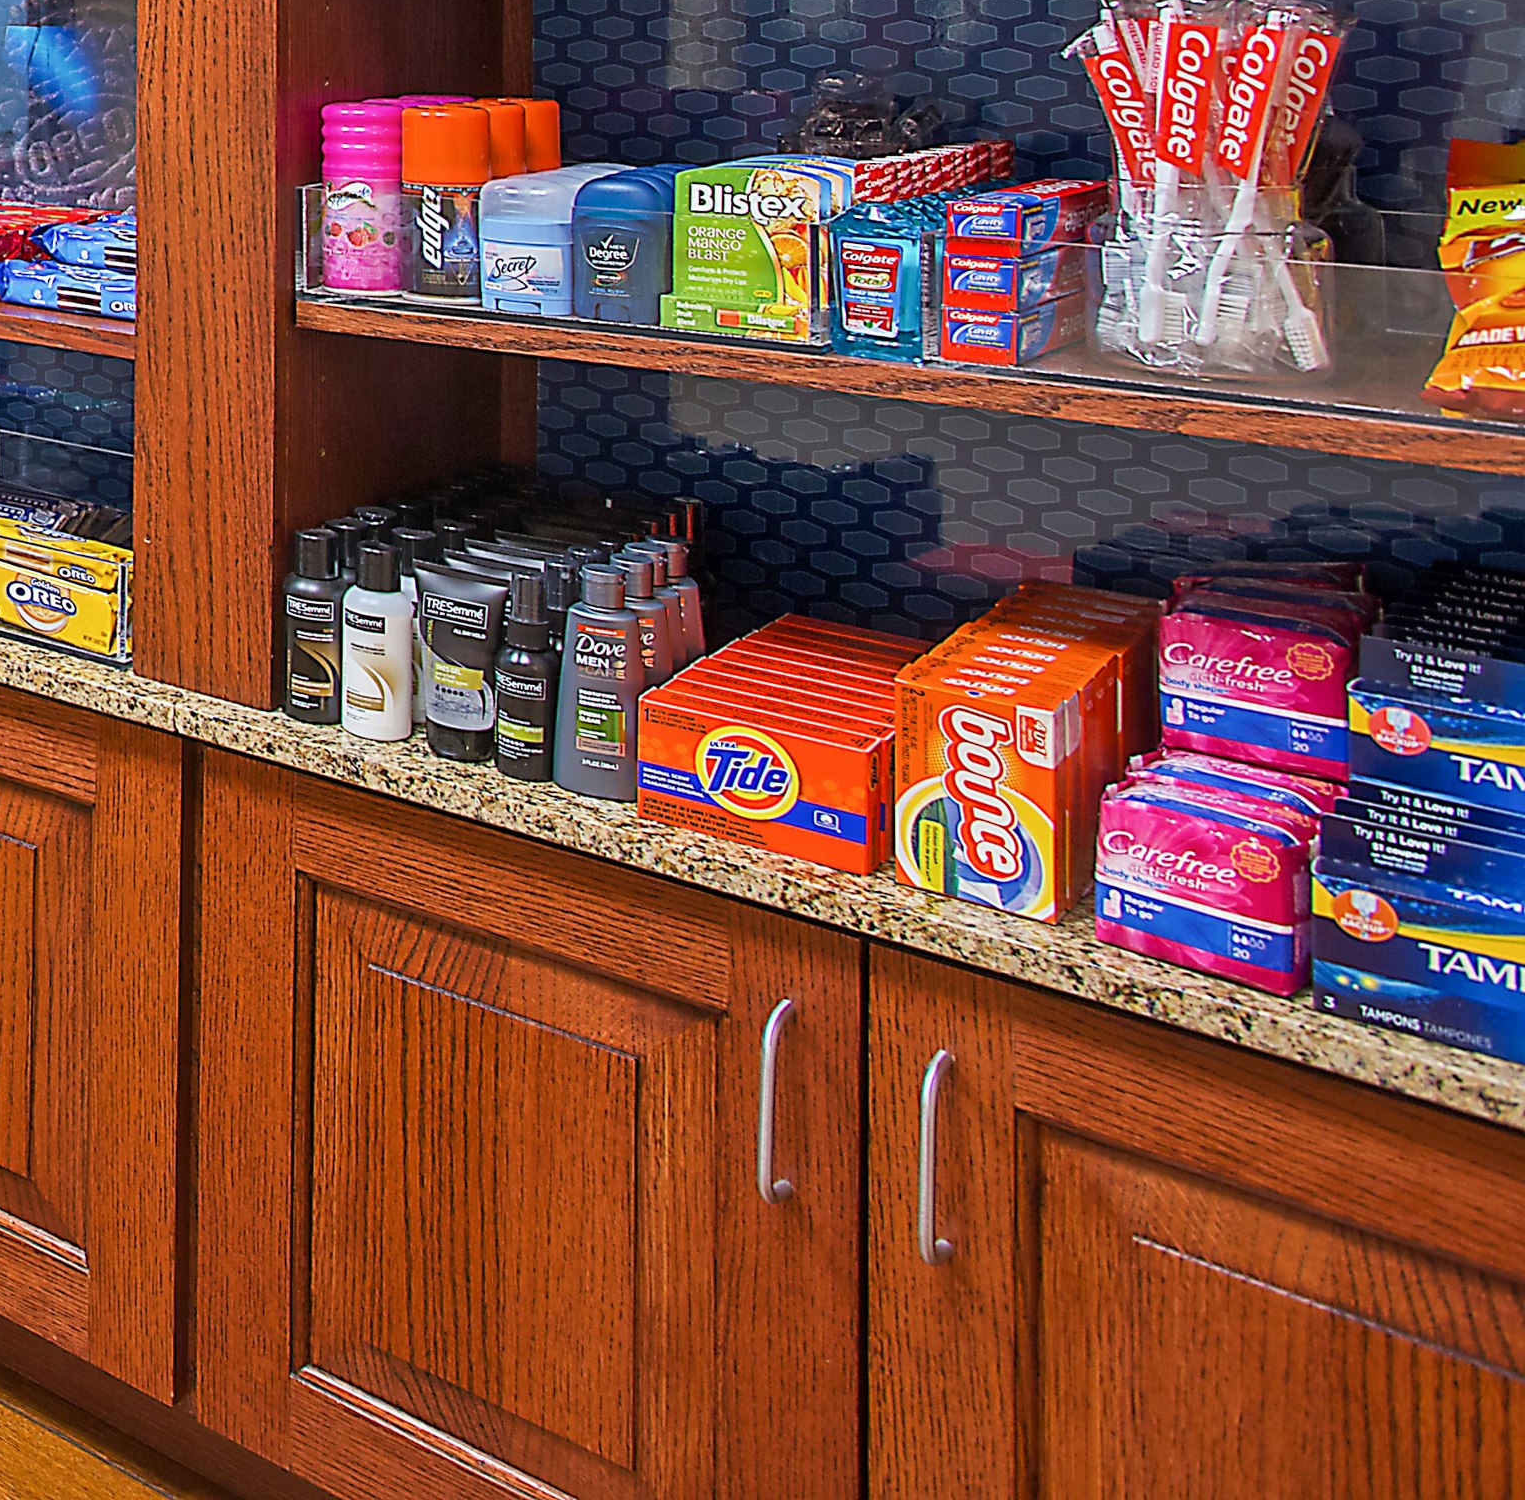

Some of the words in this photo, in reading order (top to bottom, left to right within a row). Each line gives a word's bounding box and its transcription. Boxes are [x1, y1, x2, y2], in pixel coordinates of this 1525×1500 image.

[1167, 29, 1211, 164] Colgate
[1219, 34, 1275, 170] Colgate
[689, 182, 806, 219] Blistex
[953, 202, 1000, 215] Colgate
[1457, 198, 1523, 217] New
[416, 186, 449, 269] edge
[687, 226, 747, 240] ORANGE
[589, 246, 629, 260] Degree
[687, 237, 742, 251] MANGO
[687, 247, 728, 261] BLAST
[842, 252, 897, 266] Colgate
[951, 257, 998, 270] Colgate
[493, 256, 536, 278] Secret
[851, 275, 885, 287] Total
[969, 273, 1000, 284] Cavity
[950, 311, 997, 323] Colgate
[1458, 327, 1512, 346] MADE
[30, 578, 59, 593] Golden
[59, 568, 95, 584] OREO
[9, 582, 75, 614] OREO
[426, 597, 484, 621] TRESemmé
[576, 635, 626, 658] Dove
[576, 656, 610, 669] MEN
[1164, 643, 1292, 684] Carefree
[1190, 672, 1267, 692] acti-fresh
[705, 749, 790, 794] Tide
[951, 710, 1016, 872] bounce
[1103, 831, 1236, 886] Carefree
[1129, 862, 1211, 891] acti-fresh
[1125, 895, 1164, 912] Regular
[1233, 947, 1249, 959] 20
[1323, 996, 1336, 1008] 3
[1360, 1005, 1420, 1030] TAMPONS
[1423, 1021, 1491, 1049] TAMPONES
